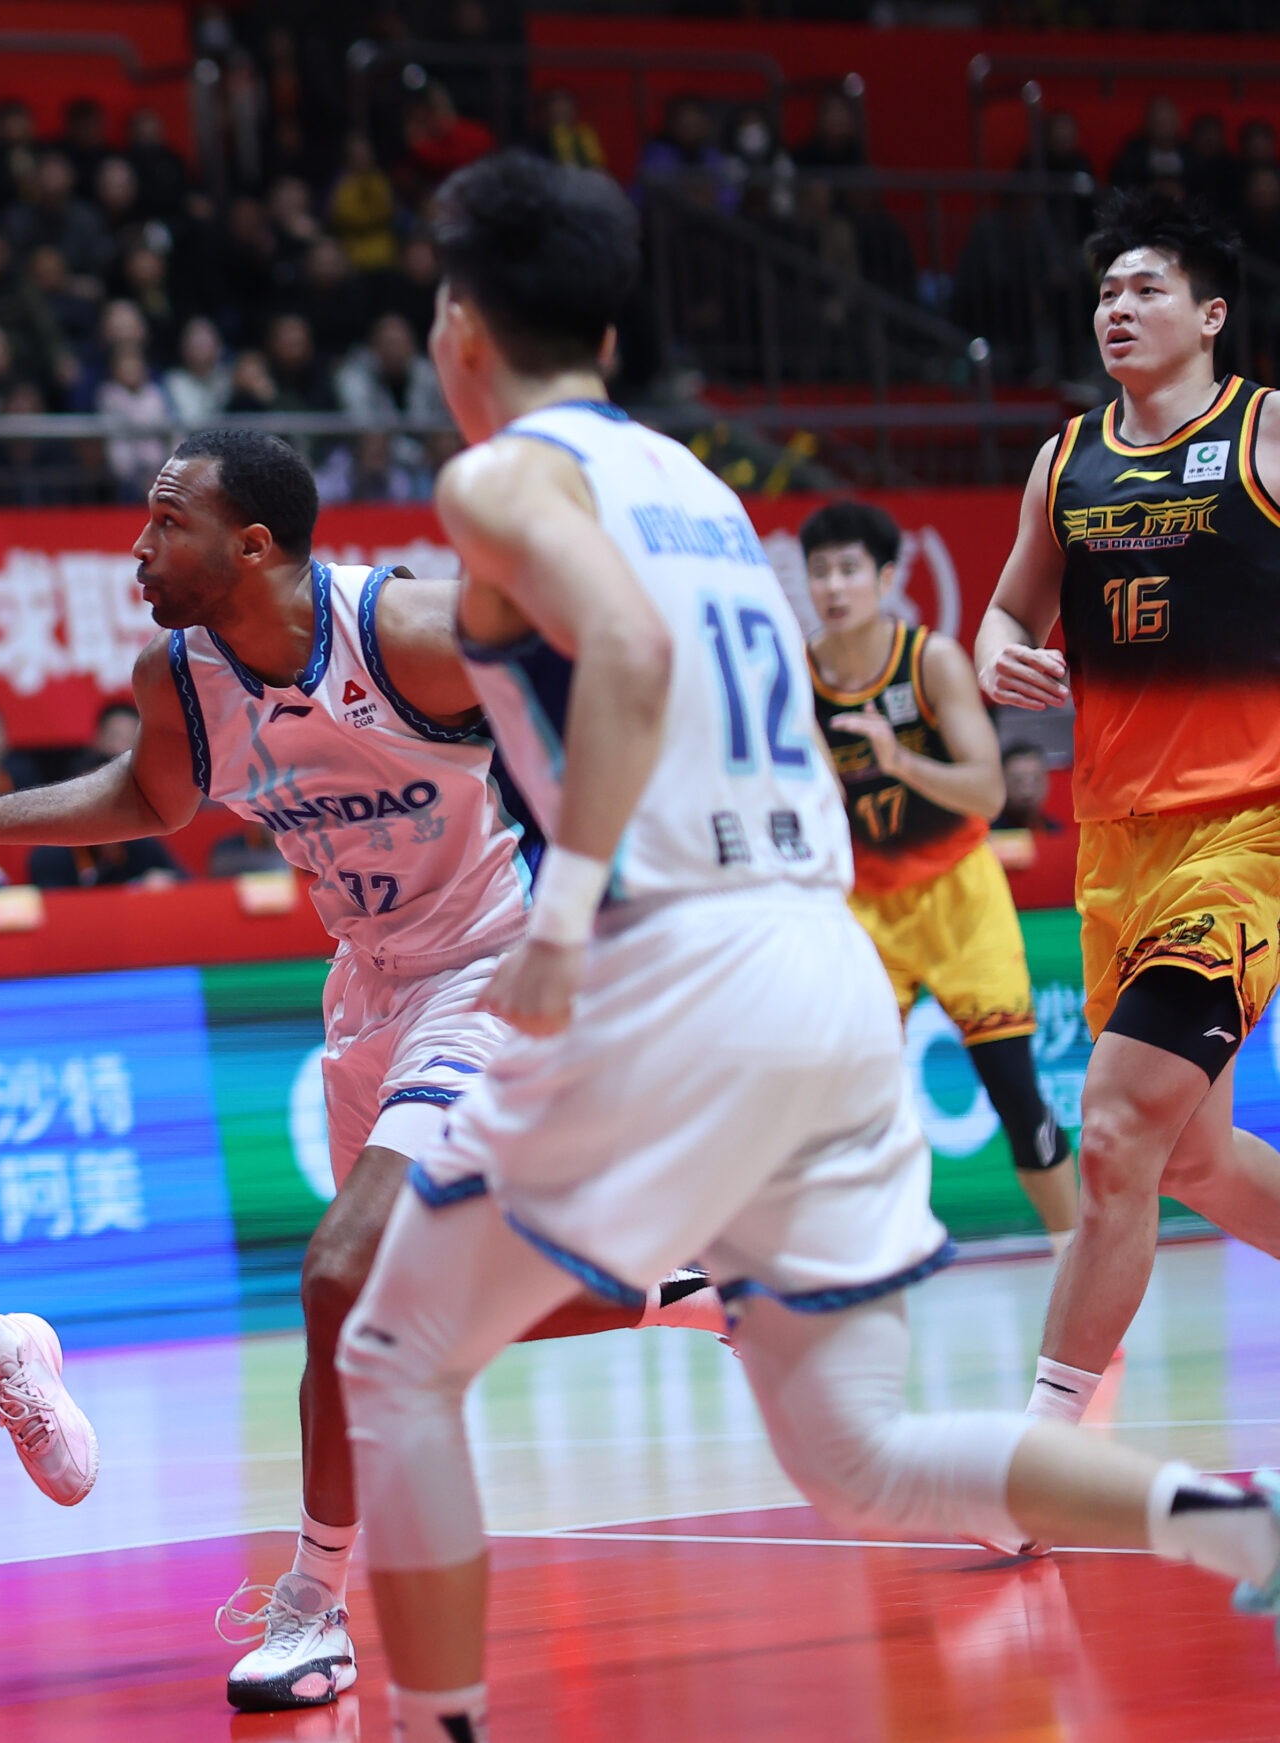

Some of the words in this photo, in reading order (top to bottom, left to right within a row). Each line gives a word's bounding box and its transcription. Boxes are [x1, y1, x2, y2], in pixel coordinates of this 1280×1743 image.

[1111, 535, 1186, 551] DRAGONS
[1103, 576, 1170, 644] 16
[699, 591, 814, 778] 12
[353, 715, 375, 729] CGB
[856, 783, 907, 842] 17
